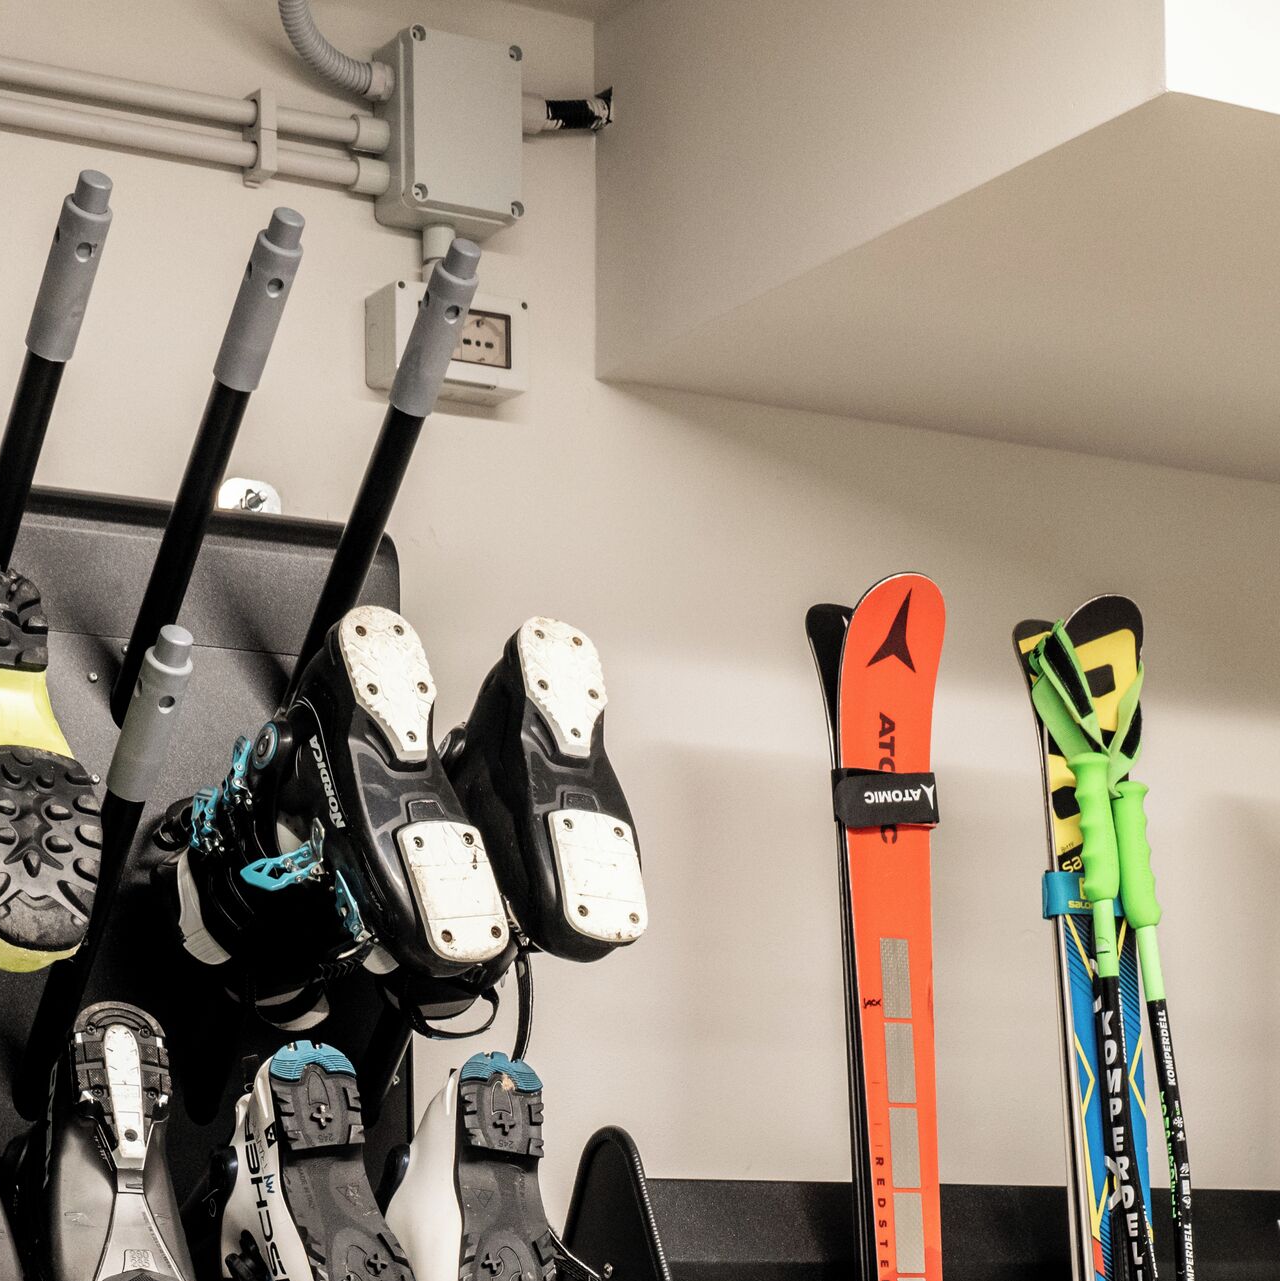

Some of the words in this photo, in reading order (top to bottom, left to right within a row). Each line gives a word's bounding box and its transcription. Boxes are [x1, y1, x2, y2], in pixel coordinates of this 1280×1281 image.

[310, 733, 347, 829] NORDICA
[863, 788, 922, 804] ATOMIC
[879, 712, 898, 844] ATOC
[1158, 1009, 1176, 1086] KOMPERDELL
